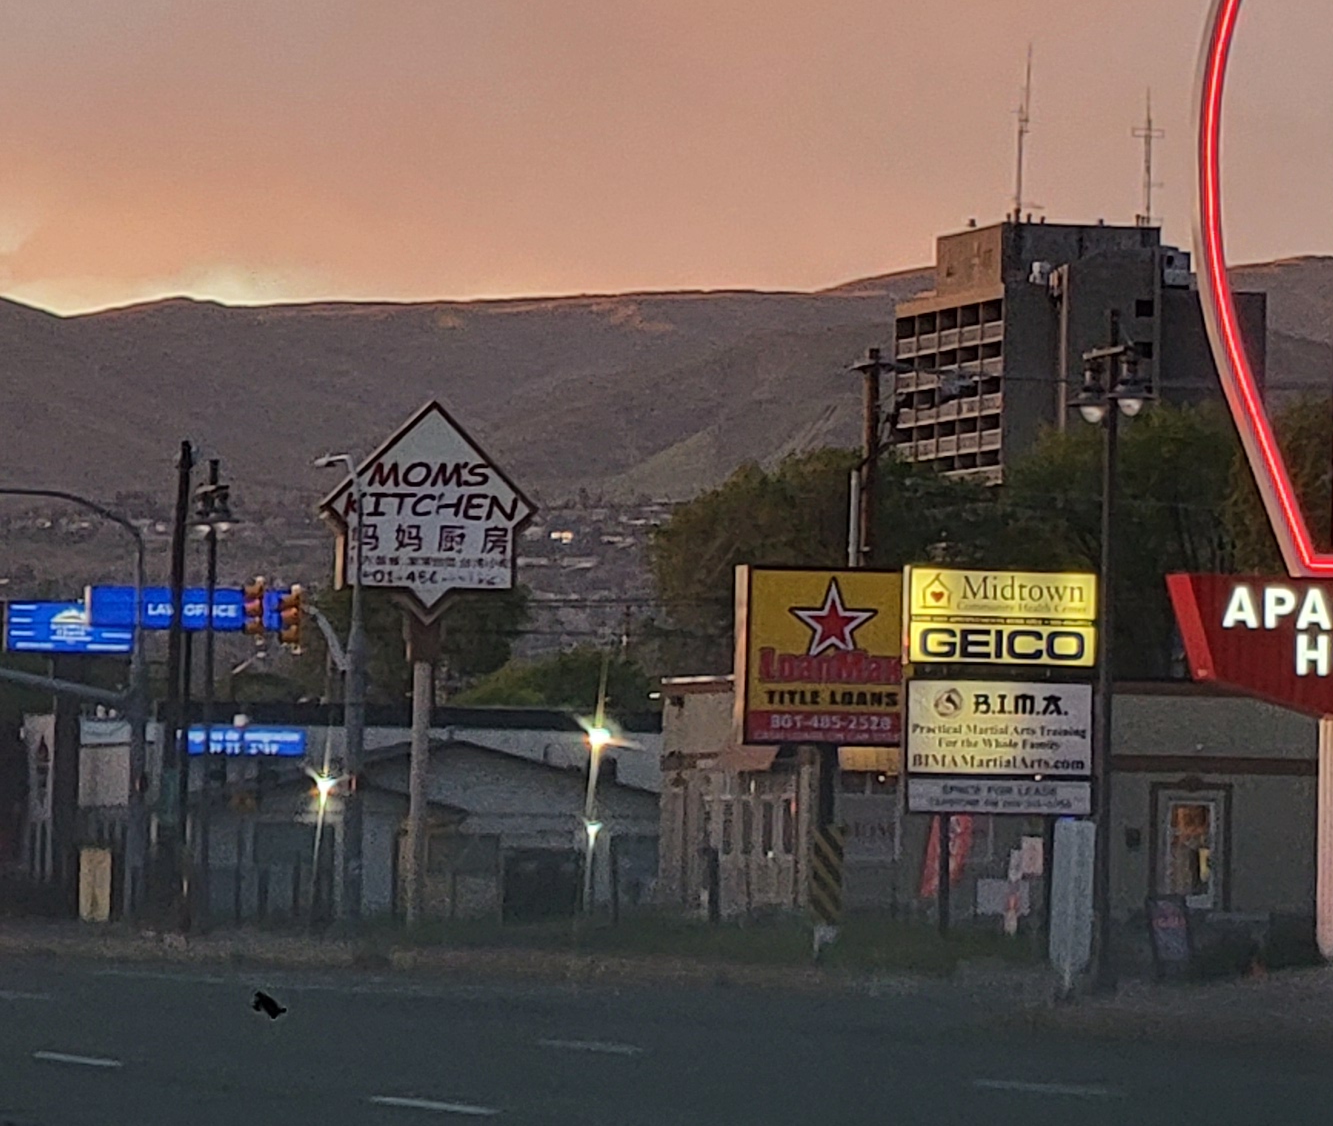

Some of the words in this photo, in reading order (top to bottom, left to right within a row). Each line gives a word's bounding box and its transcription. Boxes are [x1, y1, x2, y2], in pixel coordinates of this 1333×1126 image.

[367, 461, 492, 488] MOM'S
[343, 491, 518, 521] KITCHEN
[962, 575, 1084, 603] Midtown
[919, 628, 1086, 661] GEICO
[766, 690, 821, 705] TITLE
[830, 691, 899, 706] LOANS
[973, 694, 1069, 716] B.I.M.A.
[938, 738, 957, 748] For
[961, 738, 979, 748] the
[1012, 726, 1036, 736] Arts
